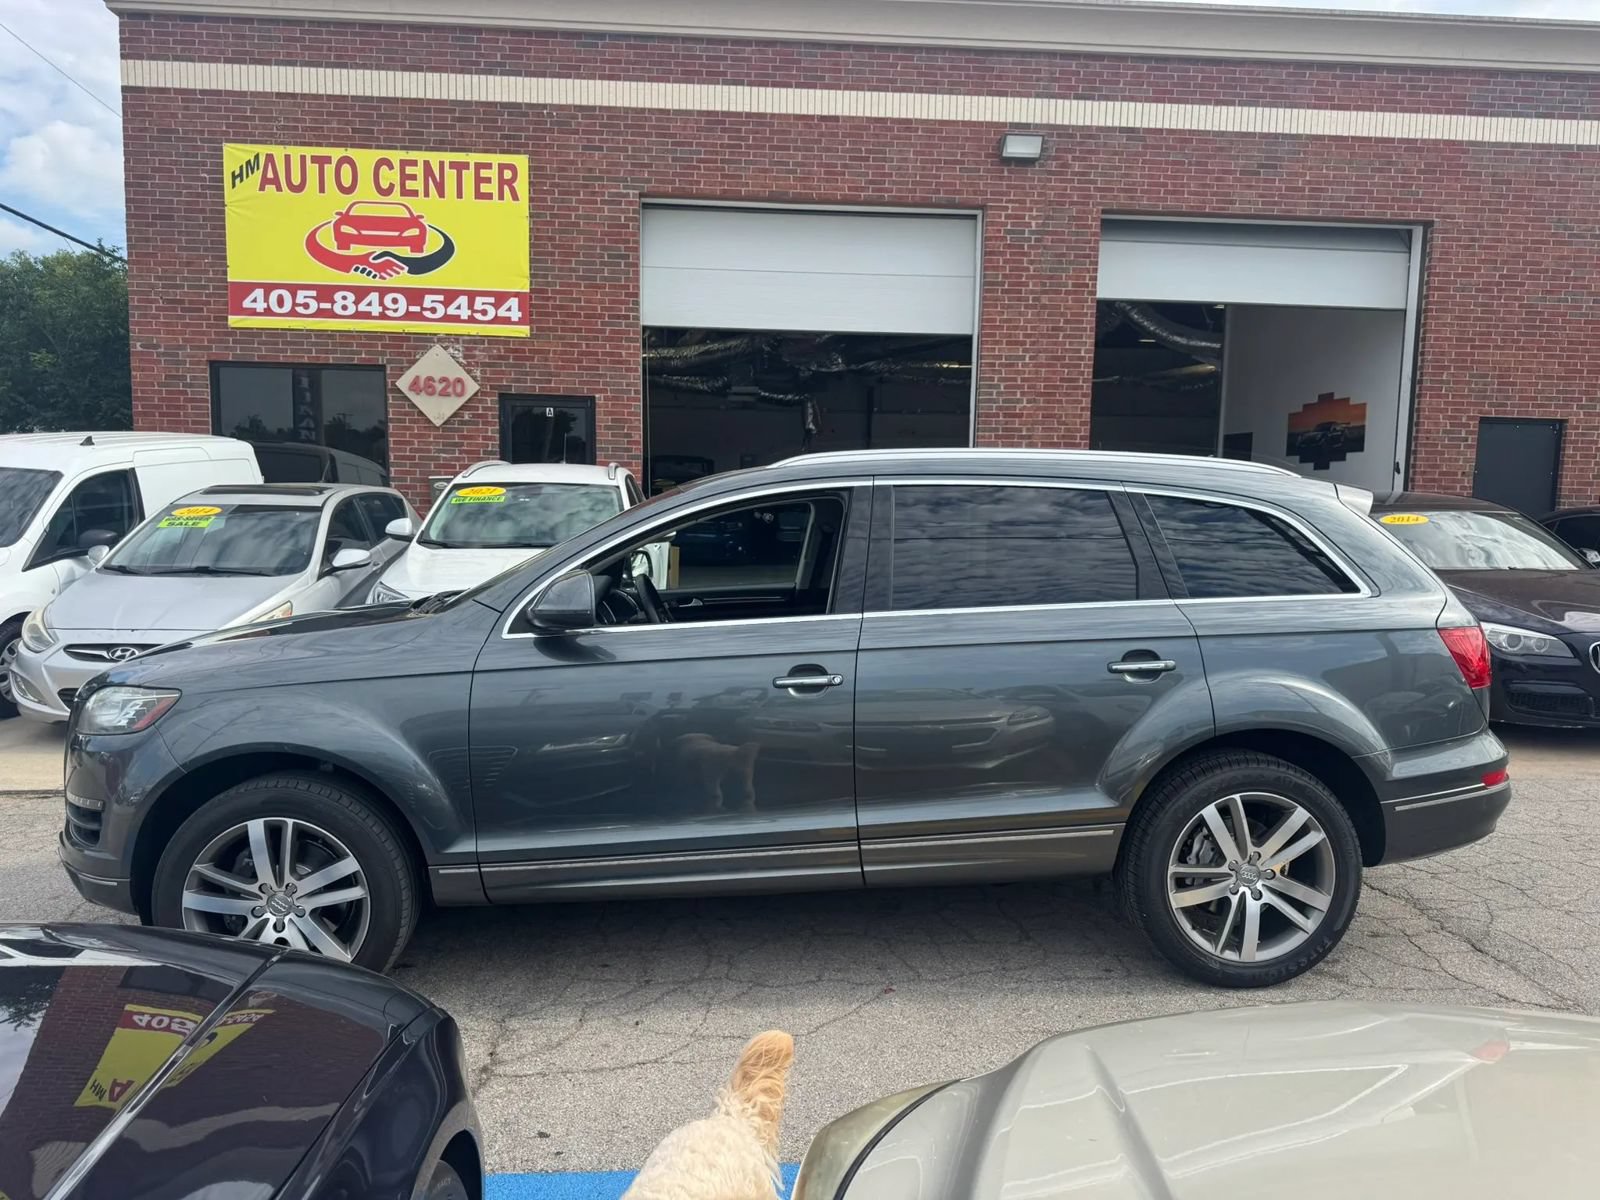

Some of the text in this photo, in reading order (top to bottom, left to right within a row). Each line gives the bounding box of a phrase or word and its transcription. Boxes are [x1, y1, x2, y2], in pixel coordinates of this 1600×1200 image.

[230, 152, 521, 202] HM AUTO CENTER
[242, 288, 522, 322] 405-849-5454
[408, 375, 466, 398] 4620
[1389, 515, 1420, 523] 2014
